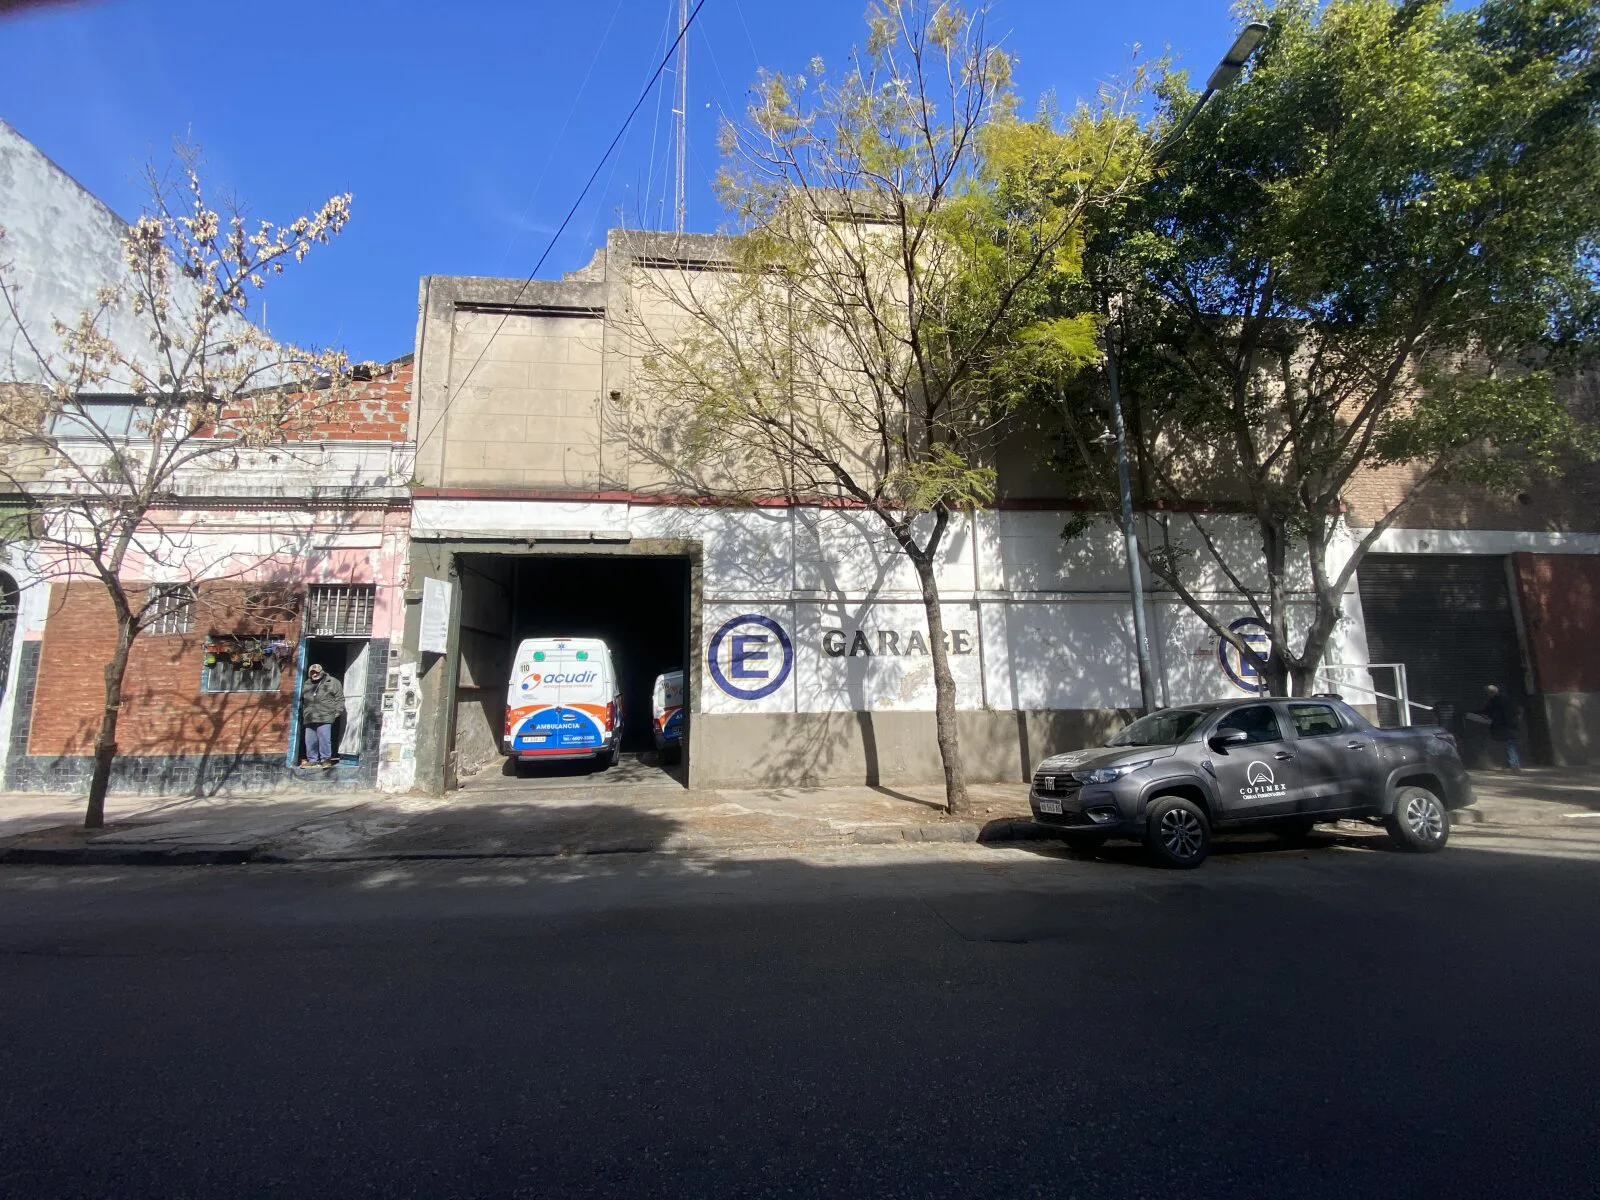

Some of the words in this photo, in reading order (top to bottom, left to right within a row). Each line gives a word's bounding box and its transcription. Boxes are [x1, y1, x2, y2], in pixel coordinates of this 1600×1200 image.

[729, 634, 769, 680] E
[520, 664, 530, 672] 110
[543, 670, 597, 684] acudir
[1239, 783, 1287, 795] COPIMEX
